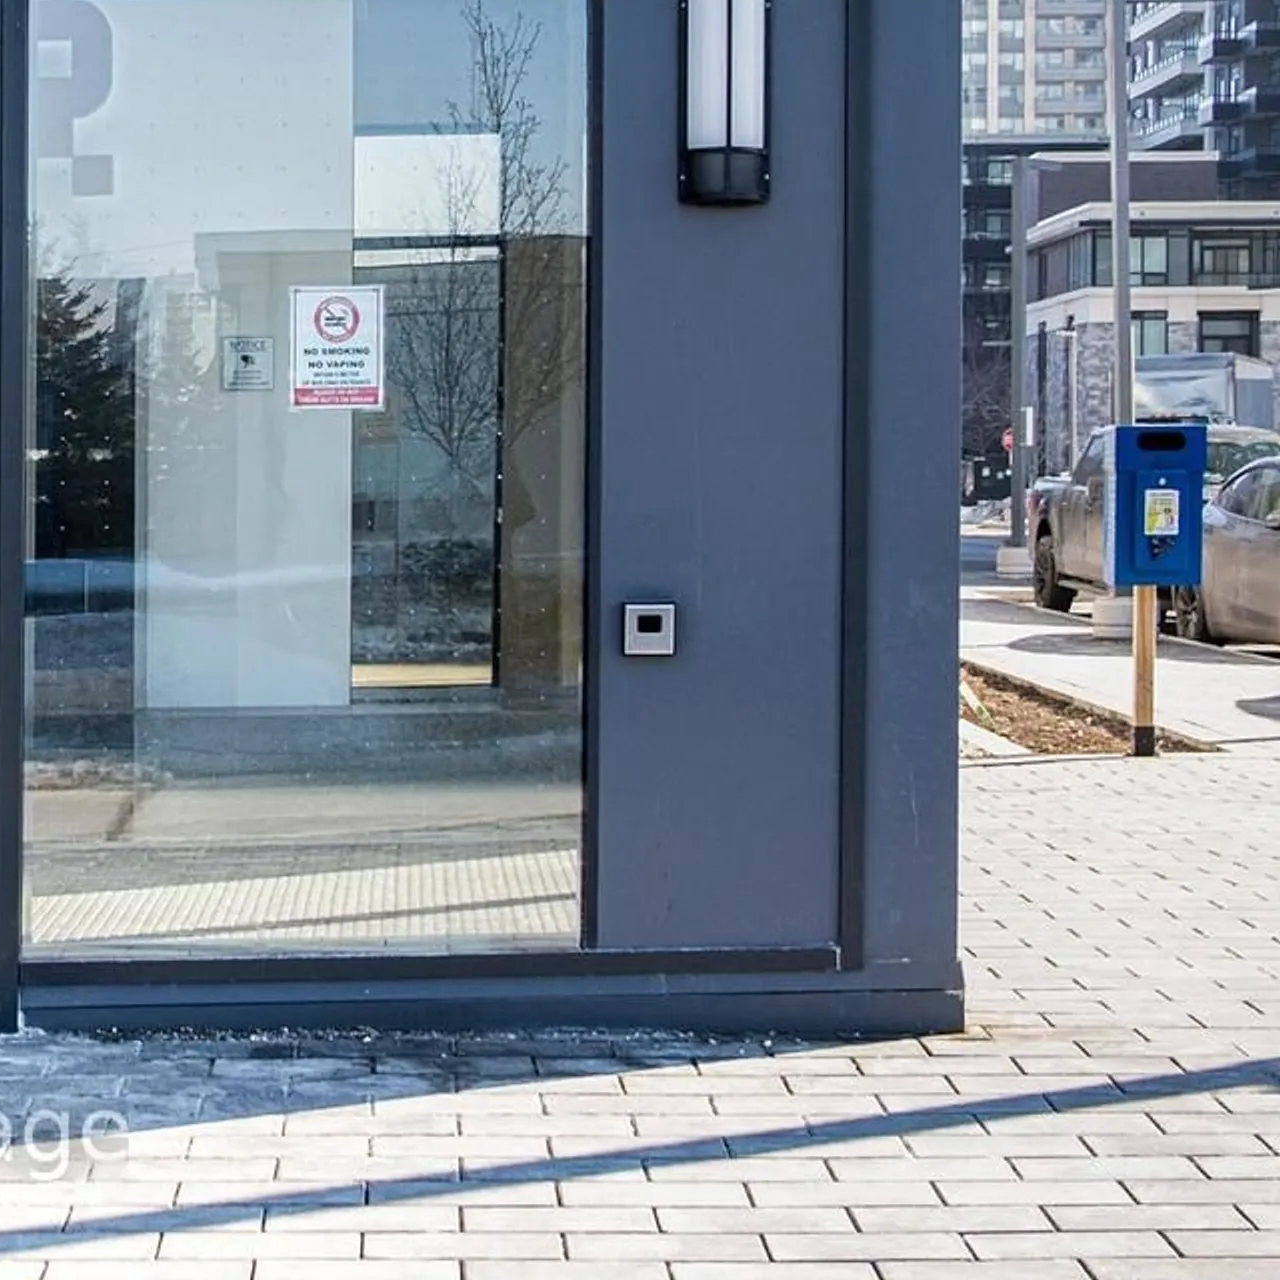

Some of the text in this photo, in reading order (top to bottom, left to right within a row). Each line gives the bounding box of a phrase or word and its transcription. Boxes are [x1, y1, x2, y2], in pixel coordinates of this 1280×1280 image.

[303, 346, 371, 356] NO SMOKING
[307, 359, 366, 369] NO VAPING
